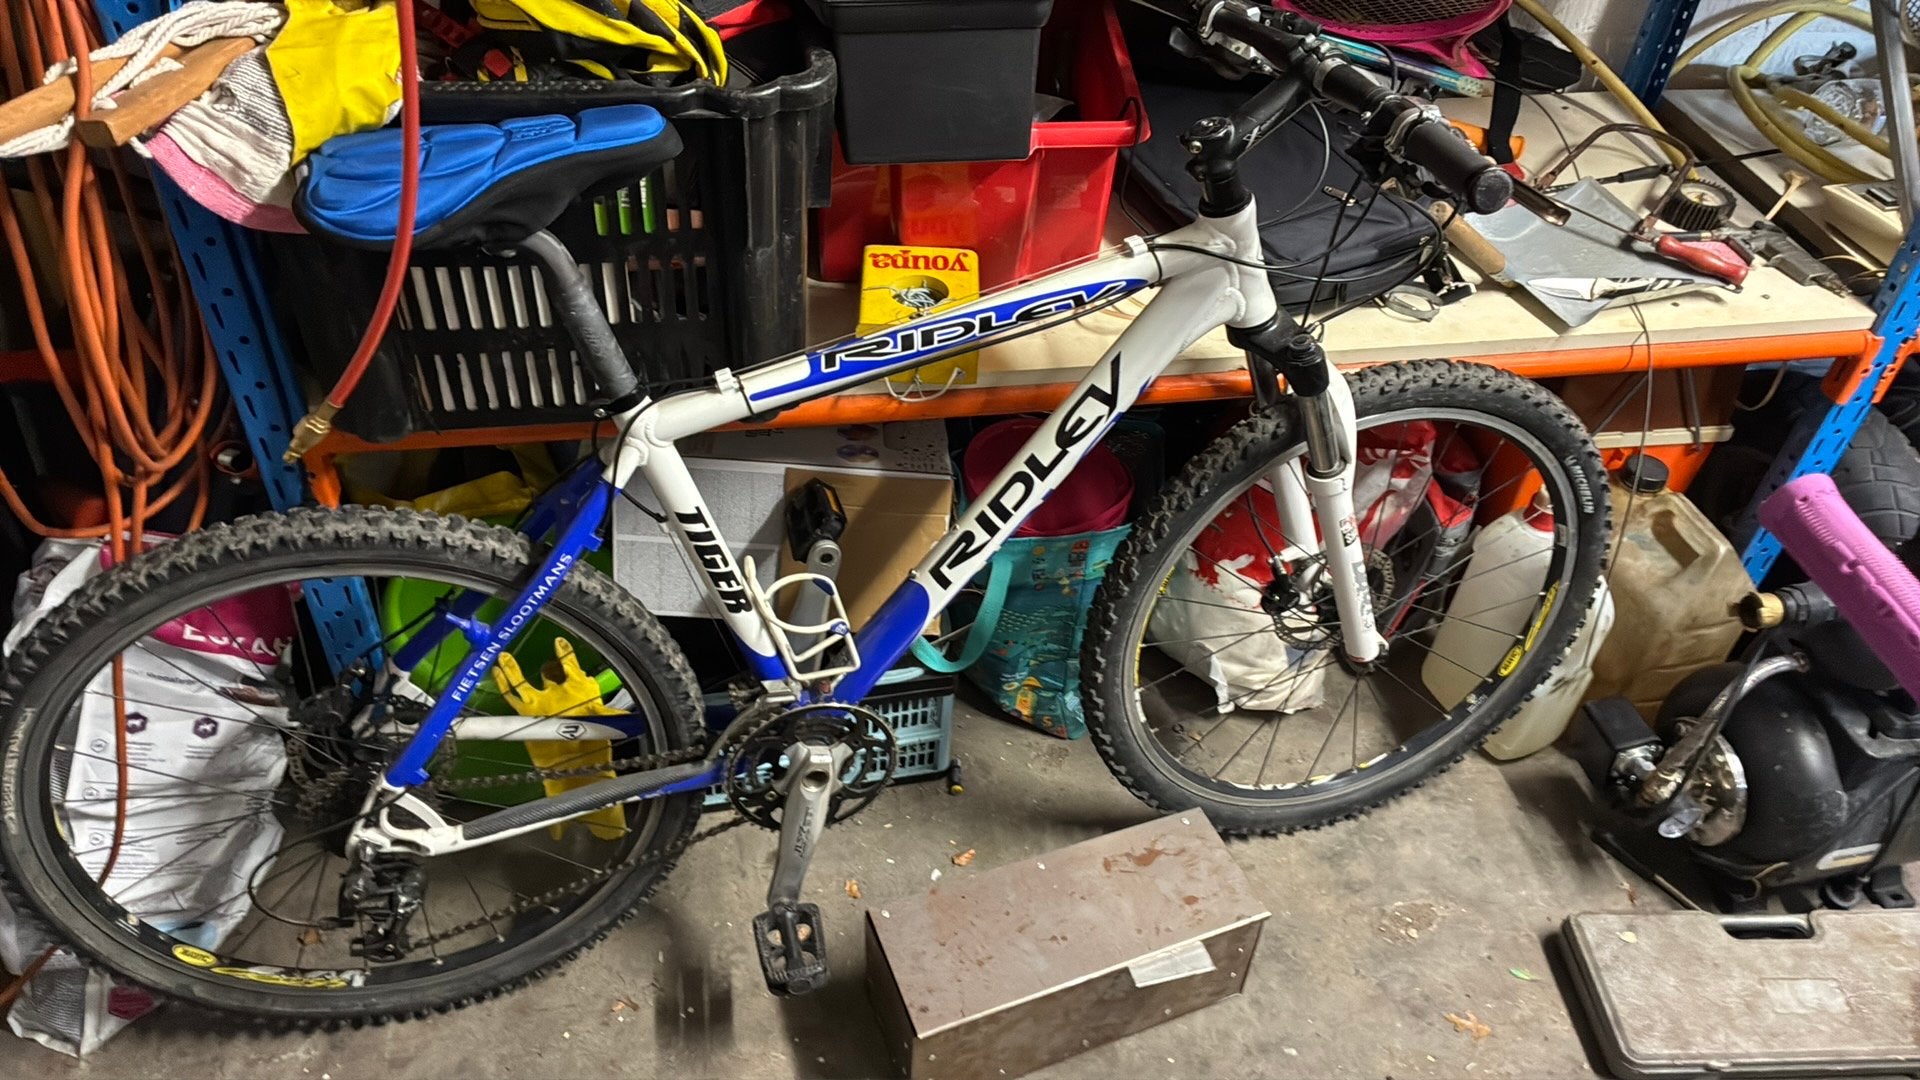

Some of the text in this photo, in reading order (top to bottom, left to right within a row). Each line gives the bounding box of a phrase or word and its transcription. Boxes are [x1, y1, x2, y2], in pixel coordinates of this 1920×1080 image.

[869, 250, 969, 272] youpa
[821, 281, 1126, 370] RIDLEY
[928, 351, 1121, 590] RIDLEY
[1570, 465, 1595, 513] MICHELIN
[674, 506, 753, 614] TIGER
[451, 552, 573, 702] FIETSEN SLOOTMANS
